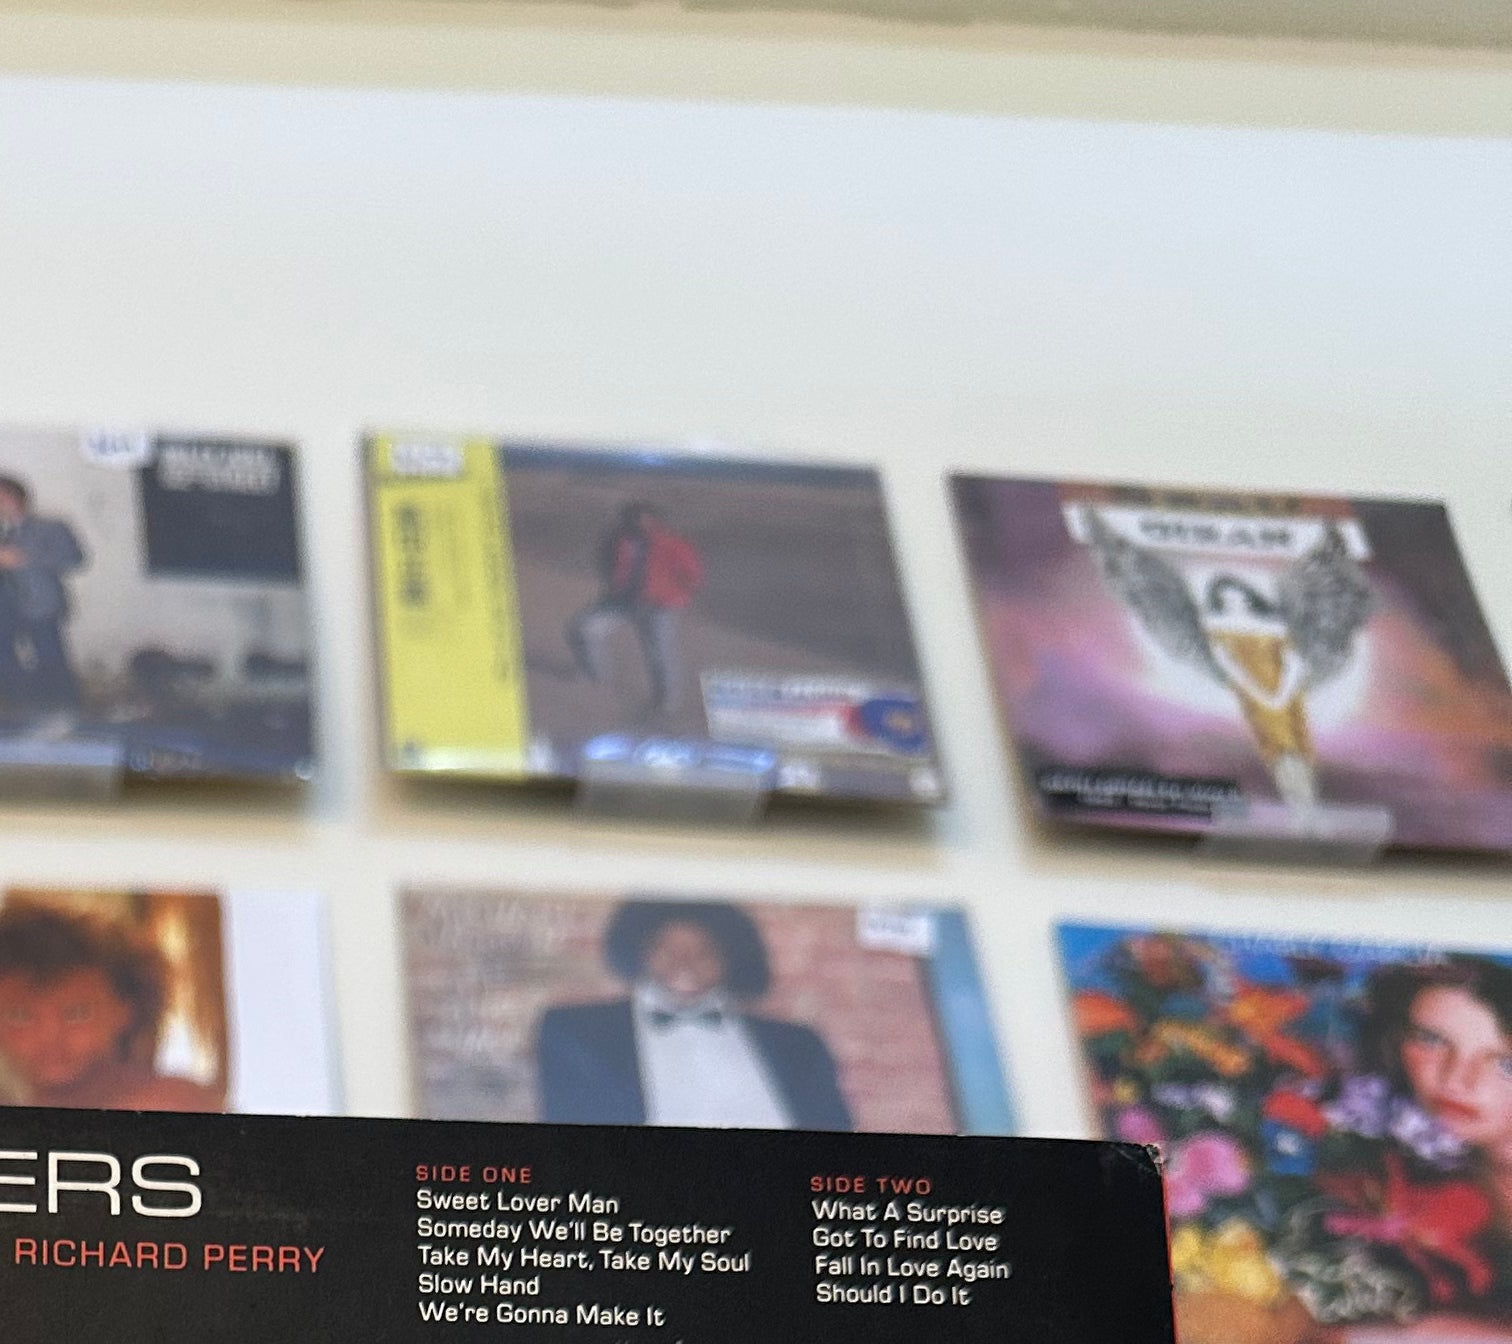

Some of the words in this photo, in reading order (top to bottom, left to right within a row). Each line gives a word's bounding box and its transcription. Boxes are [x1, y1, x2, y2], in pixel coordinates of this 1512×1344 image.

[416, 1165, 471, 1182] SIDE
[483, 1167, 532, 1183] ONE
[810, 1176, 866, 1193] SIDE
[876, 1177, 932, 1195] TWO
[417, 1189, 489, 1210] Sweet
[497, 1192, 561, 1213] Lover
[569, 1193, 619, 1214] Man
[811, 1200, 877, 1221] What
[883, 1202, 901, 1222] A
[907, 1202, 1005, 1226] Surprise
[417, 1217, 521, 1242] Someday
[528, 1220, 586, 1241] We'll
[593, 1222, 623, 1242] Be
[628, 1222, 732, 1247] Together
[812, 1227, 855, 1247] Got
[861, 1228, 887, 1248] To
[893, 1228, 940, 1249] Find
[946, 1230, 999, 1251] Love
[16, 1238, 188, 1270] RICHARD
[205, 1244, 326, 1273] PERRY
[417, 1245, 470, 1266] Take
[477, 1247, 514, 1271] My
[520, 1247, 594, 1271] Heart,
[598, 1250, 651, 1271] Take
[658, 1252, 695, 1275] My
[701, 1252, 751, 1272] Soul
[815, 1254, 853, 1275] Fall
[860, 1255, 880, 1275] In
[887, 1256, 939, 1277] Love
[946, 1258, 1011, 1282] Again
[418, 1273, 473, 1295] Slow
[480, 1275, 541, 1296] Hand
[816, 1282, 891, 1303] Should
[899, 1284, 906, 1304] I
[913, 1284, 945, 1305] Do
[952, 1285, 973, 1305] It
[419, 1301, 489, 1323] We're
[496, 1302, 569, 1325] Gonna
[576, 1304, 640, 1326] Make
[647, 1305, 667, 1327] It
